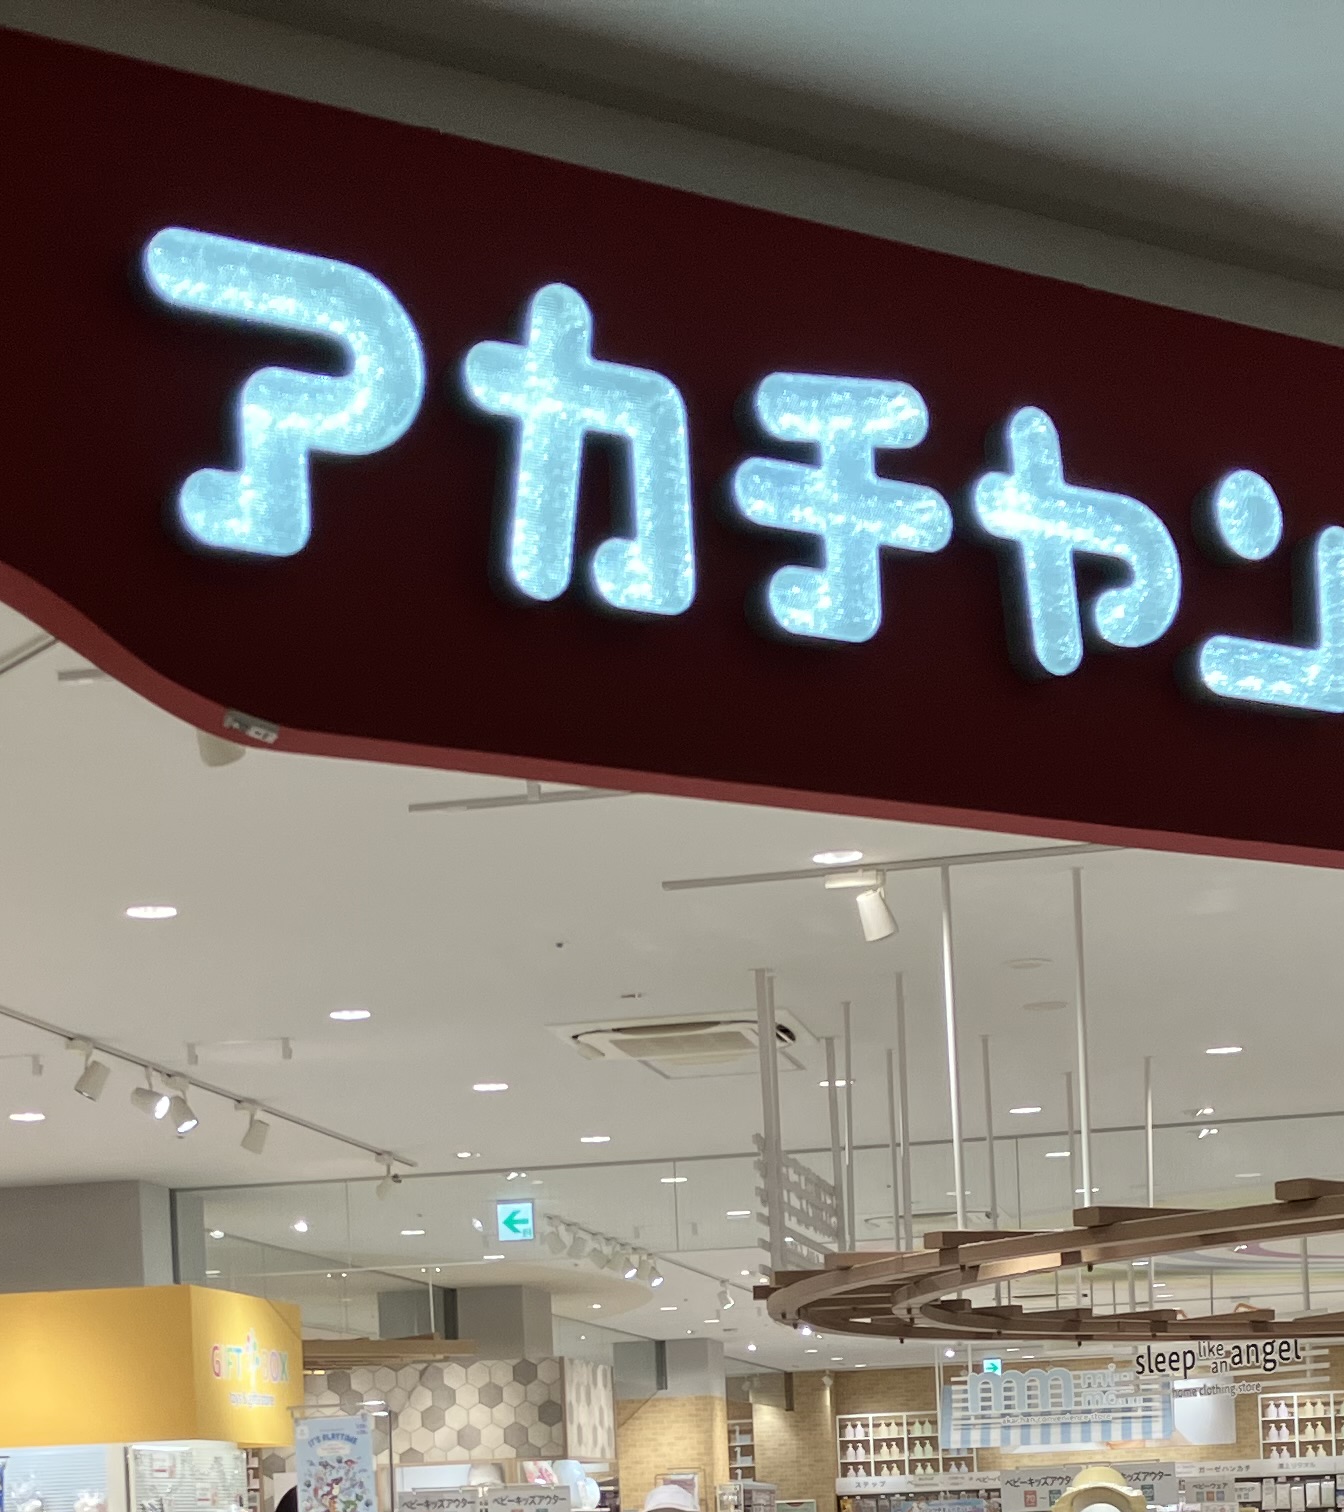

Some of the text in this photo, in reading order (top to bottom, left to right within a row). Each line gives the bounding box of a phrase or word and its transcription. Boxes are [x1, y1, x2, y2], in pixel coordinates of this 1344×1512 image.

[1198, 1341, 1224, 1357] like
[1231, 1339, 1302, 1372] angel
[1135, 1344, 1196, 1379] sleep
[1211, 1360, 1229, 1374] an
[1172, 1381, 1262, 1399] home clothing store
[1090, 1412, 1112, 1421] store
[1198, 1463, 1251, 1474] ガーゼハンカチ
[401, 1497, 476, 1510] ベビーキッズアウター
[492, 1494, 567, 1506] ベビーキッズアウター
